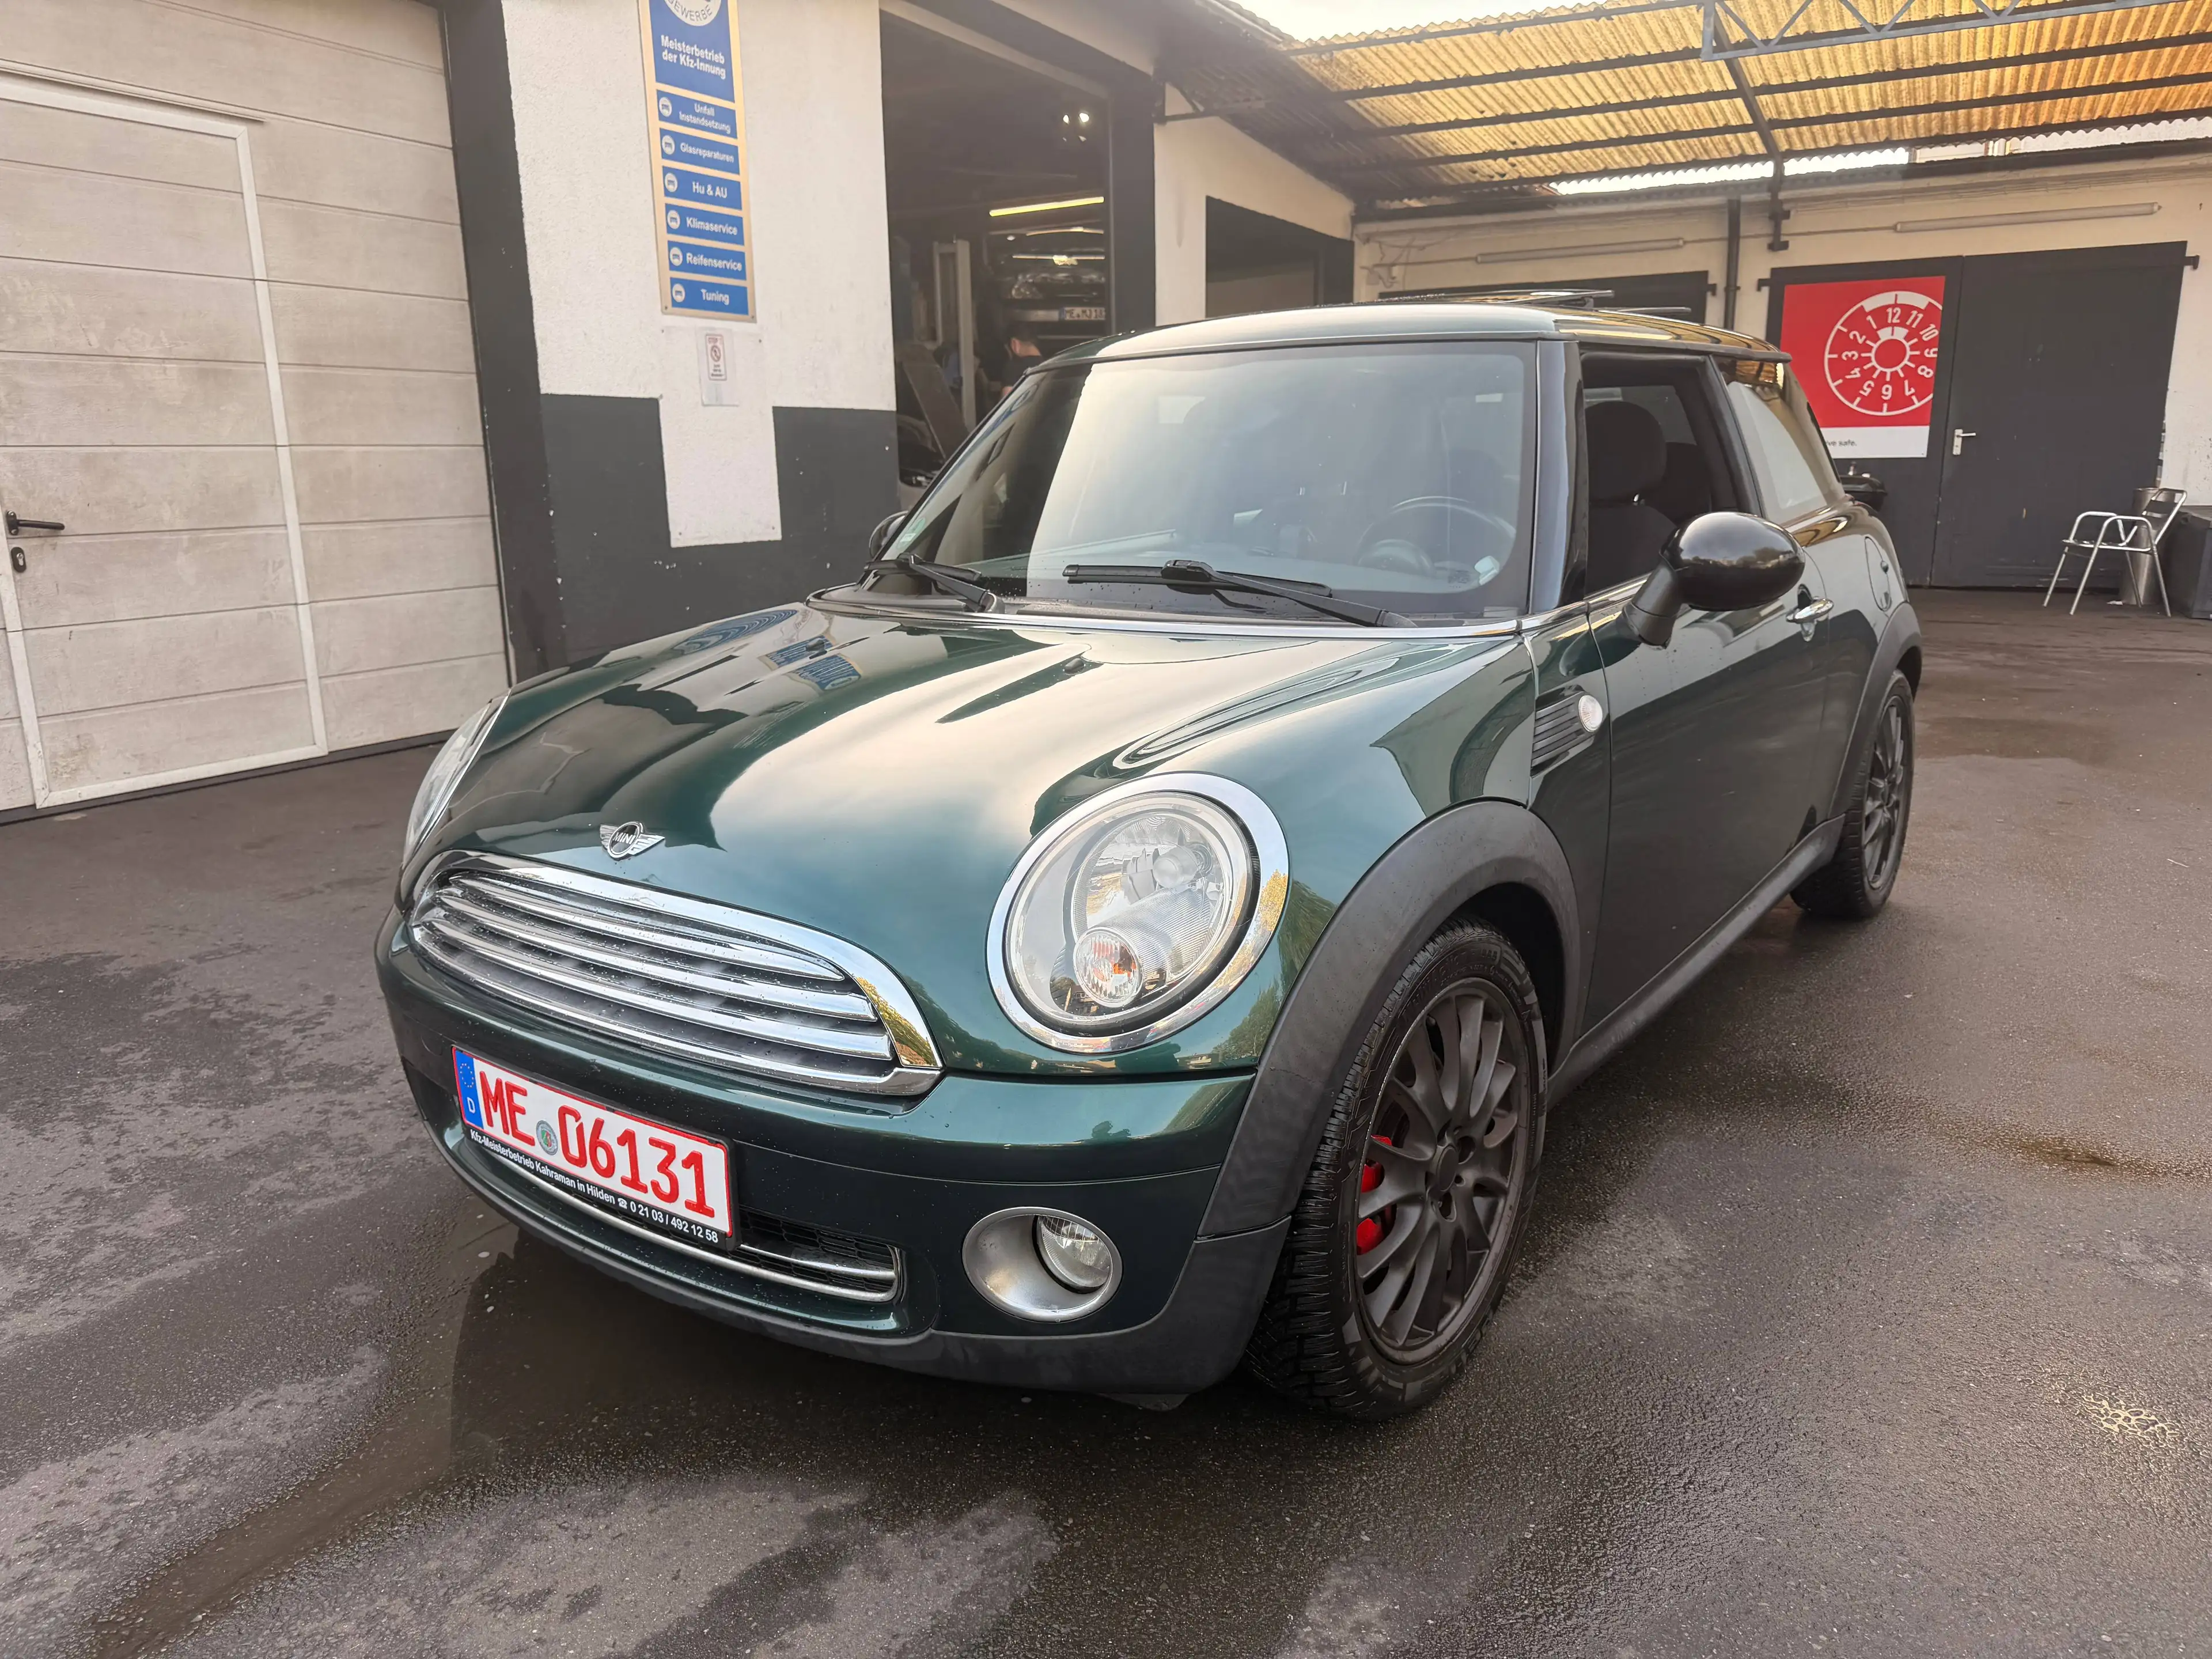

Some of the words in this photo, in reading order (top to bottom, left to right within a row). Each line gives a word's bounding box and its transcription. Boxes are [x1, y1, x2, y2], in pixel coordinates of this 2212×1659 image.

[661, 35, 725, 64] Meisterbetrieb
[662, 50, 677, 63] der
[680, 52, 726, 79] Kfz-Innung
[694, 103, 715, 116] Unfall
[679, 111, 731, 134] Instandsetzung
[680, 142, 734, 163] Glasreparaturen
[692, 181, 704, 195] Hu
[706, 184, 714, 196] &
[715, 187, 728, 198] AU
[686, 217, 738, 236] Klimaservice
[686, 252, 742, 271] Reifenservice
[700, 289, 729, 305] Tuning
[1866, 315, 1877, 329] 1
[1886, 307, 1902, 323] 12
[1906, 310, 1923, 328] 11
[1849, 331, 1866, 344] 2
[1919, 324, 1939, 341] 10
[1841, 351, 1858, 361] 3
[1845, 367, 1861, 379] 4
[1917, 365, 1934, 378] 8
[1859, 380, 1875, 397] 5
[1881, 384, 1892, 400] 6
[1904, 380, 1915, 396] 7
[1838, 439, 1857, 447] safe.
[613, 832, 636, 844] MINI
[467, 1097, 476, 1113] D
[479, 1070, 536, 1147] ME
[558, 1105, 715, 1218] 06131
[470, 1129, 535, 1170] Kfz-Meisterbetrieb
[535, 1161, 576, 1188] Kahraman
[577, 1180, 585, 1193] in
[586, 1183, 615, 1205] Hilden
[630, 1202, 637, 1213] 0
[638, 1204, 649, 1218] 21
[652, 1209, 664, 1224] 03
[671, 1217, 689, 1233] 492
[691, 1224, 703, 1238] 12
[706, 1229, 718, 1243] 58
